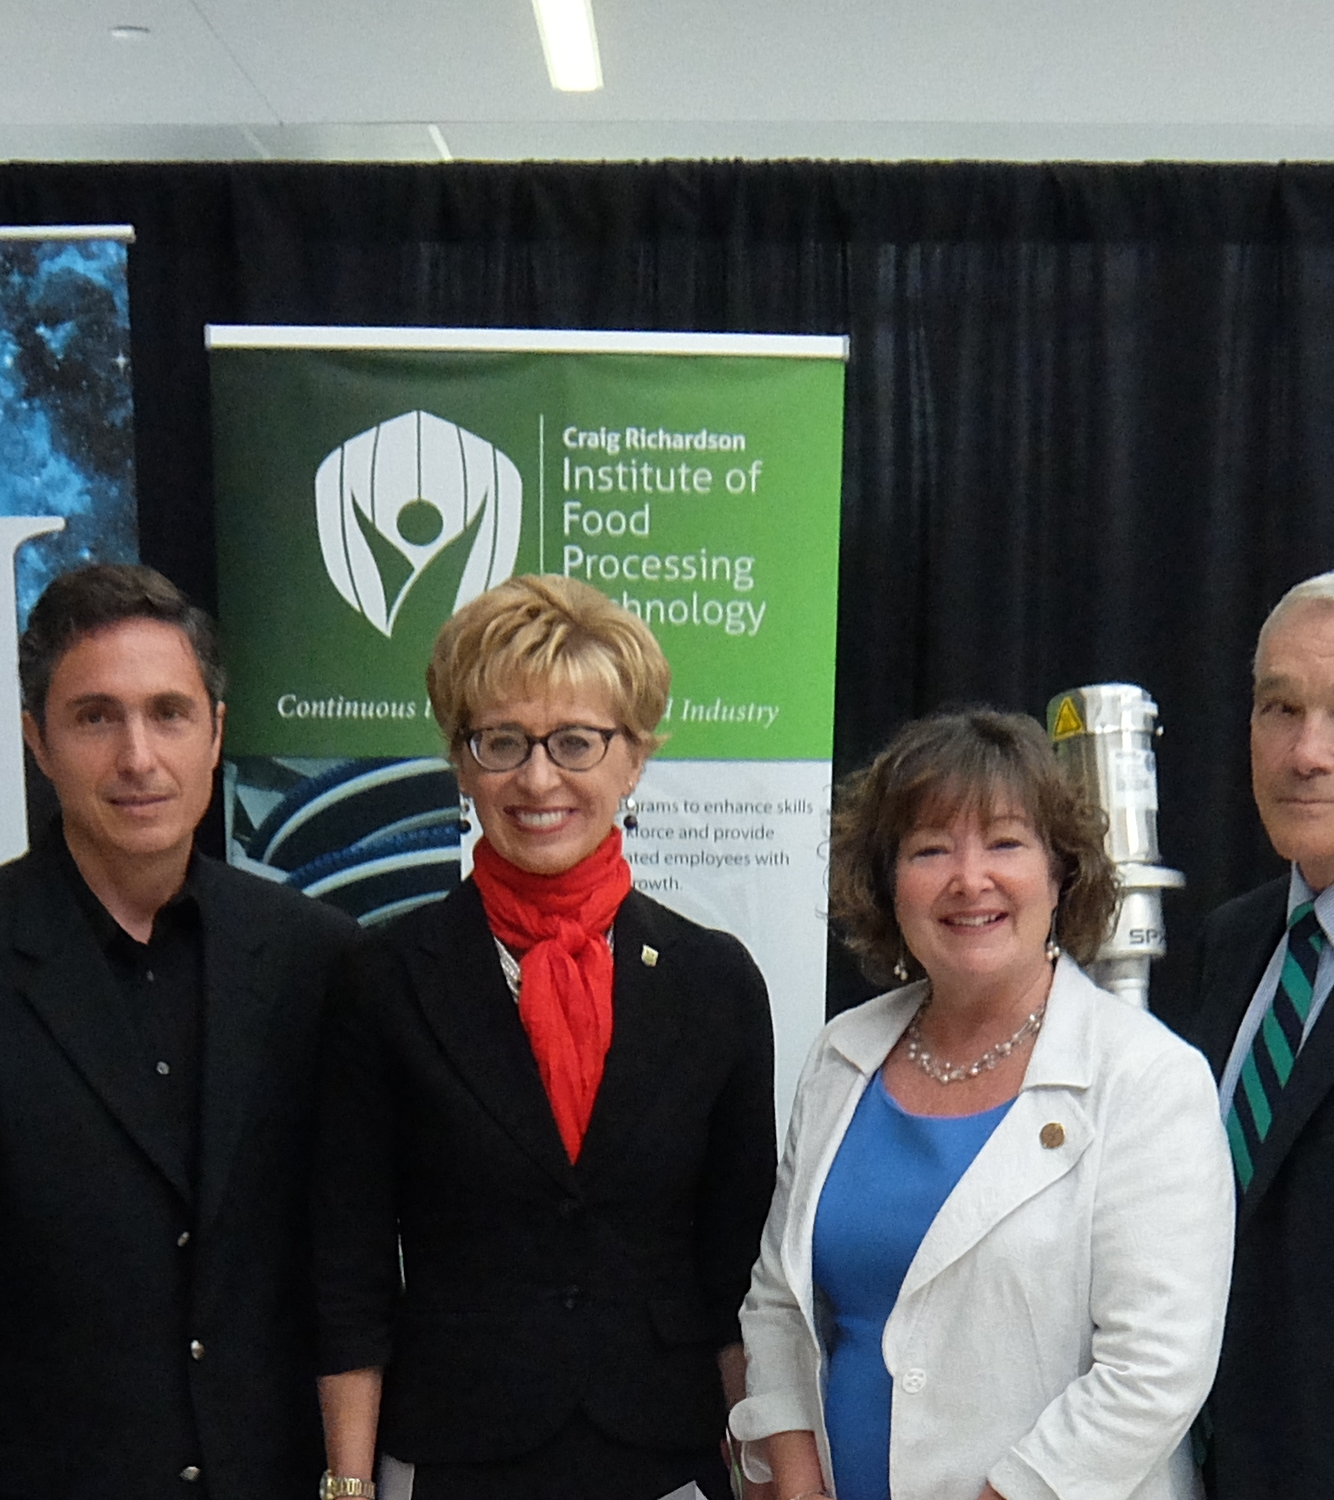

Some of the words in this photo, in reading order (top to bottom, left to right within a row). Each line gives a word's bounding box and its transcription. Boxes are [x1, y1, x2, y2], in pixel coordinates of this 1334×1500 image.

[562, 426, 621, 455] Craig
[625, 427, 746, 451] Richardson
[563, 457, 713, 493] Institute
[725, 460, 763, 494] of
[563, 501, 650, 536] Food
[563, 544, 755, 591] Processing
[613, 590, 767, 637] hnology
[277, 693, 417, 719] Continuous
[680, 696, 780, 728] Industry
[683, 799, 700, 814] to
[704, 799, 773, 815] enhance
[777, 799, 814, 815] skills
[625, 825, 675, 840] kforce
[679, 824, 709, 839] and
[713, 826, 775, 843] provide
[626, 851, 660, 865] ated
[664, 850, 751, 868] employees
[755, 852, 790, 866] with
[633, 876, 683, 891] rowth.
